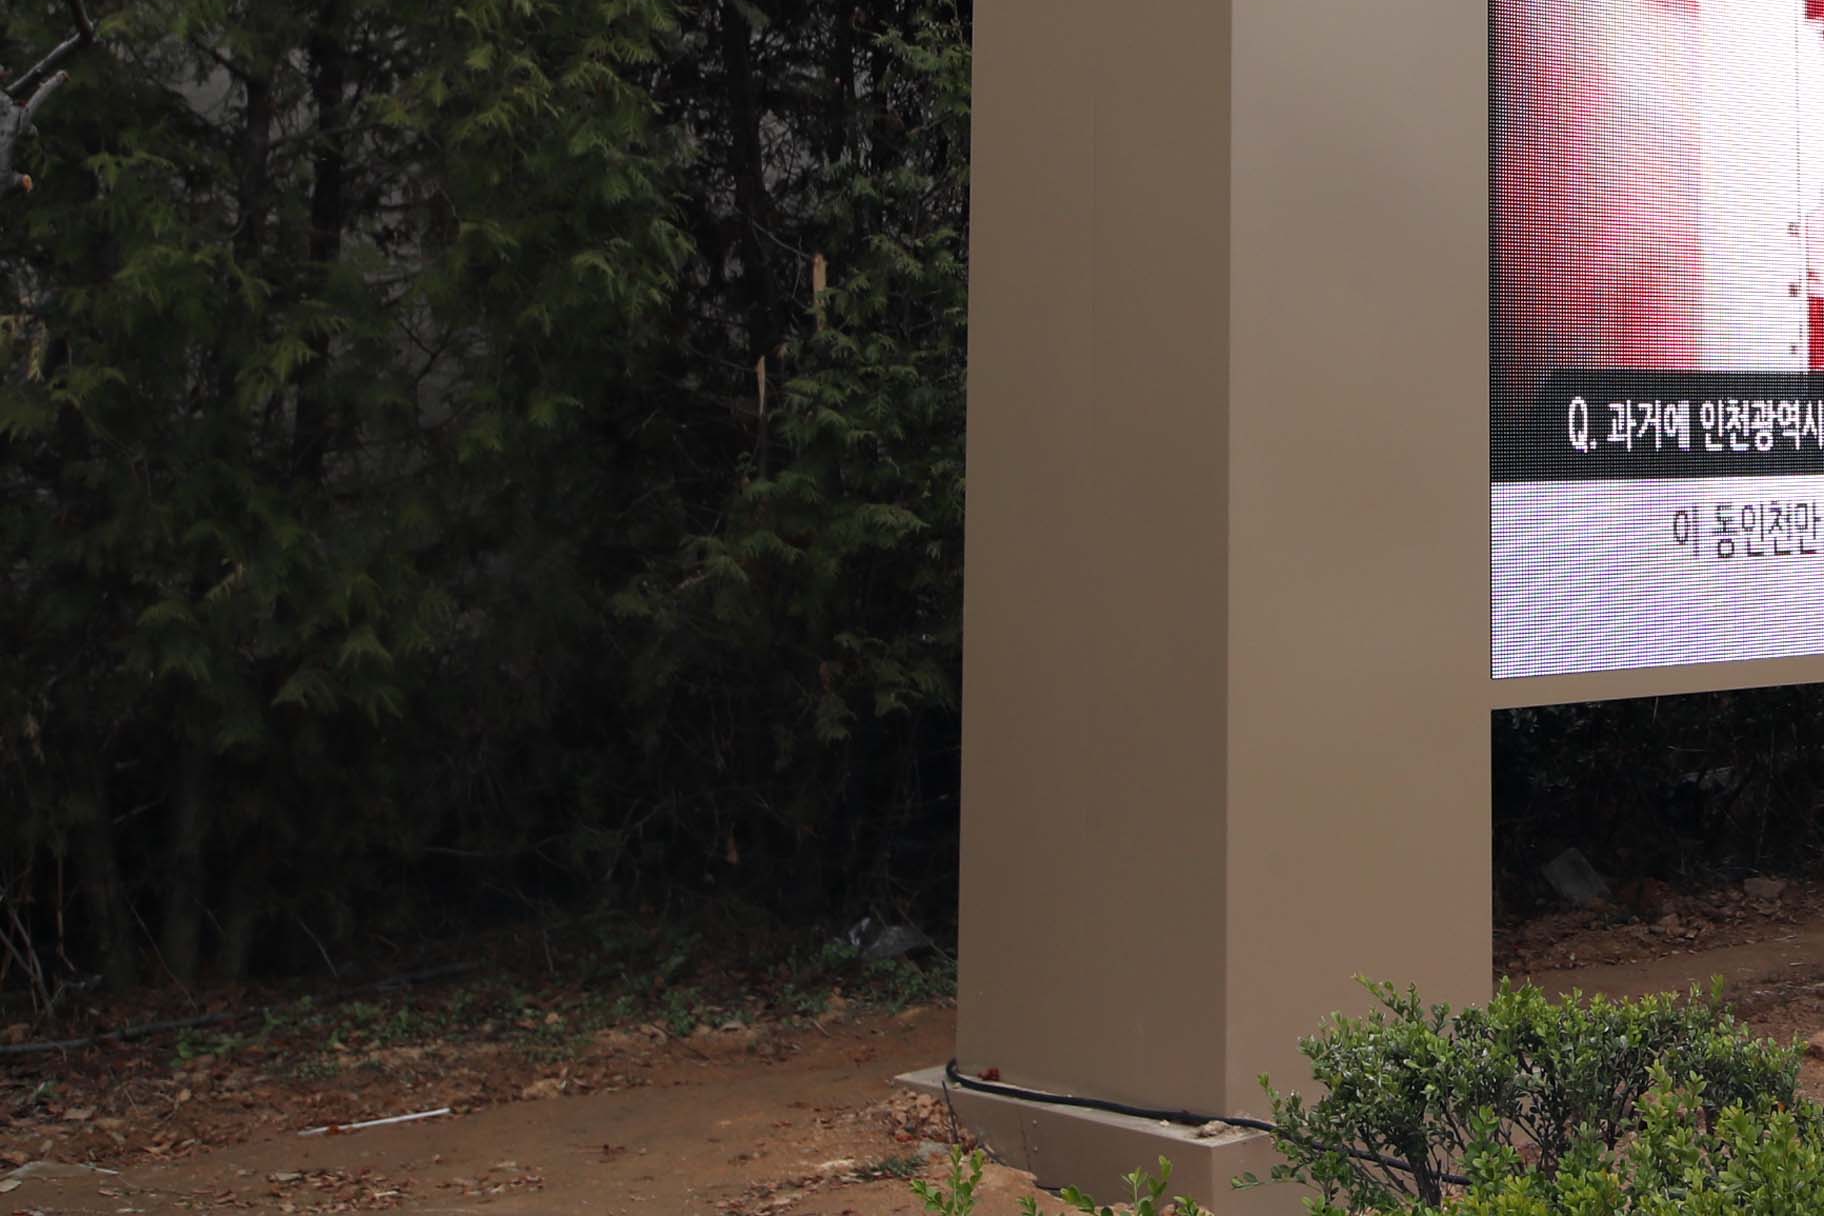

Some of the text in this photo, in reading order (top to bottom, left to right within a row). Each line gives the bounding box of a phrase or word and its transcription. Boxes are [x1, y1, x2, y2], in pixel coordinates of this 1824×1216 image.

[1568, 396, 1598, 453] Q.
[1607, 399, 1691, 453] 과거에
[1699, 399, 1824, 452] 인천광역시
[1673, 506, 1700, 556] 이
[1712, 501, 1821, 559] 동인천만
